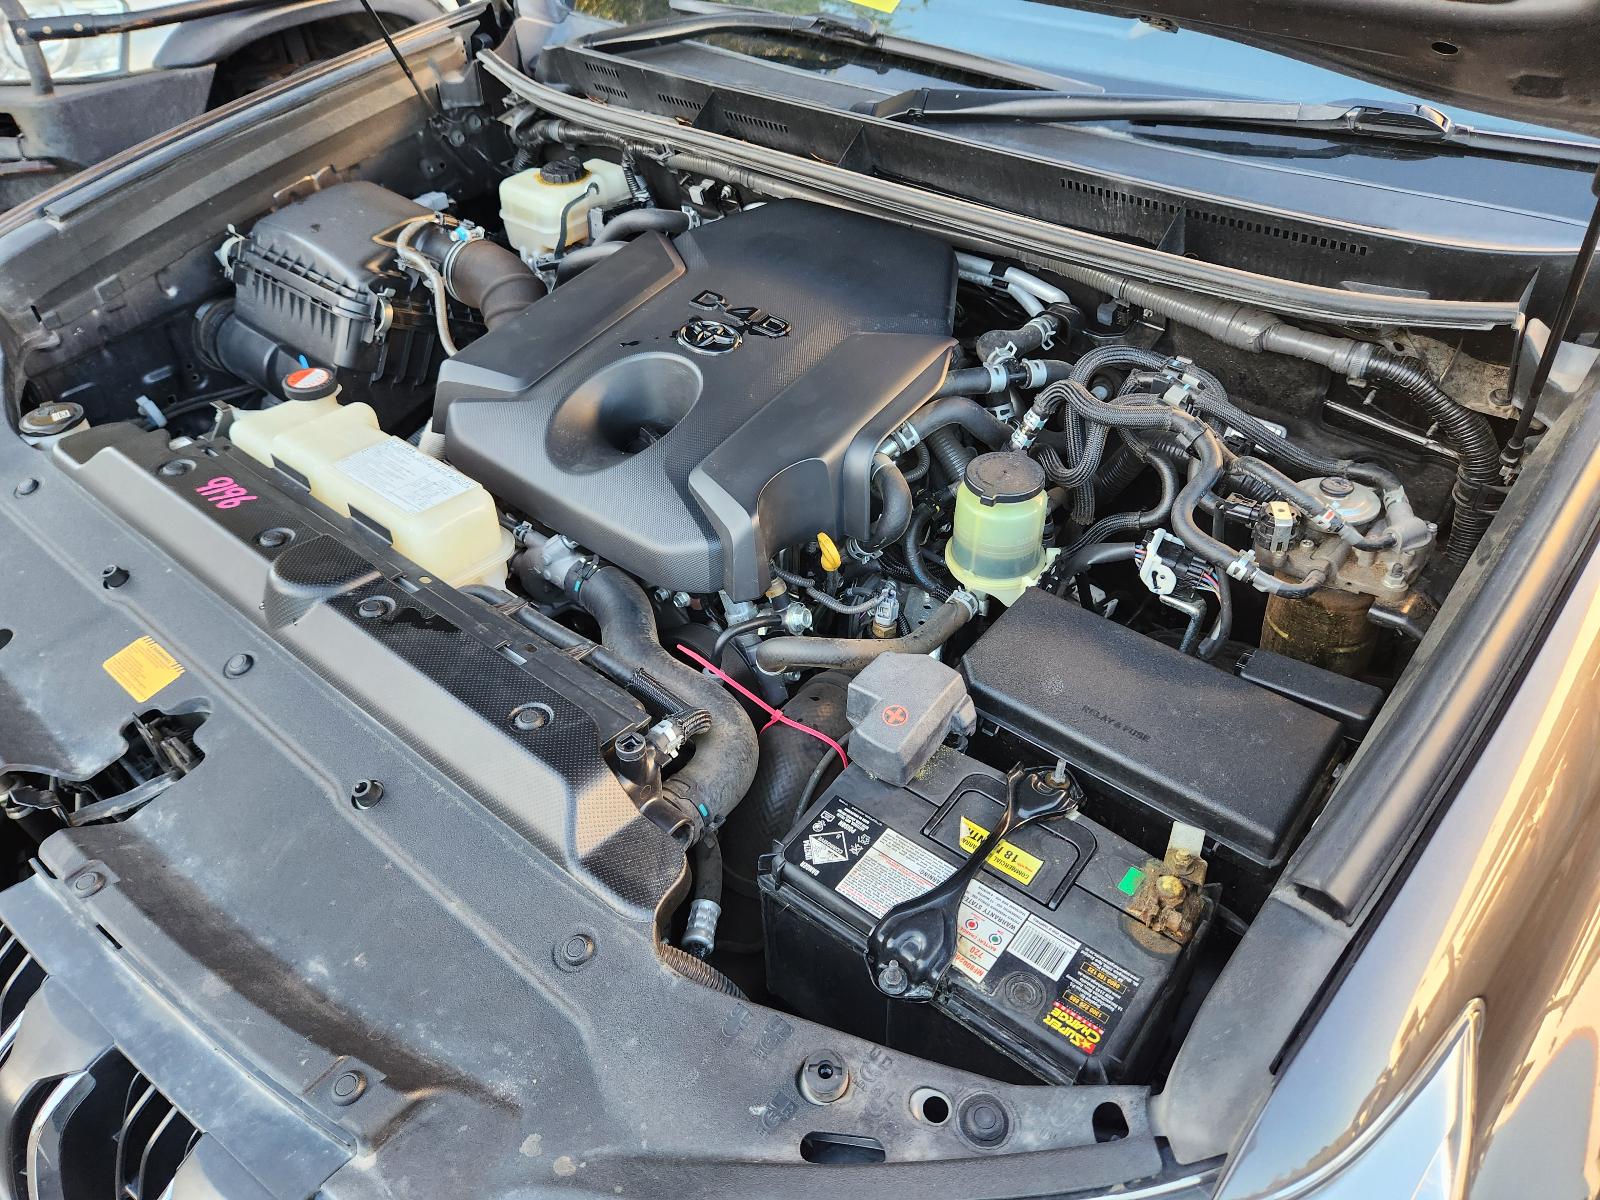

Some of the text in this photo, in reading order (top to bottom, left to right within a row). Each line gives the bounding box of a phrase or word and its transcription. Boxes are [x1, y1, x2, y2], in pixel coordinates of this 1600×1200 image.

[690, 289, 790, 336] D-4D
[1081, 704, 1115, 724] RELAY
[1122, 724, 1152, 742] FUSE
[837, 820, 856, 833] POISON
[816, 835, 843, 854] CORROSIVE
[1003, 849, 1019, 863] 18
[799, 860, 819, 875] DANGER
[918, 868, 943, 886] ARNING:
[991, 855, 1029, 880] COMMERCIAL
[982, 907, 1016, 931] WARRANTY
[969, 945, 984, 958] 720
[1049, 1006, 1102, 1044] CHARGE
